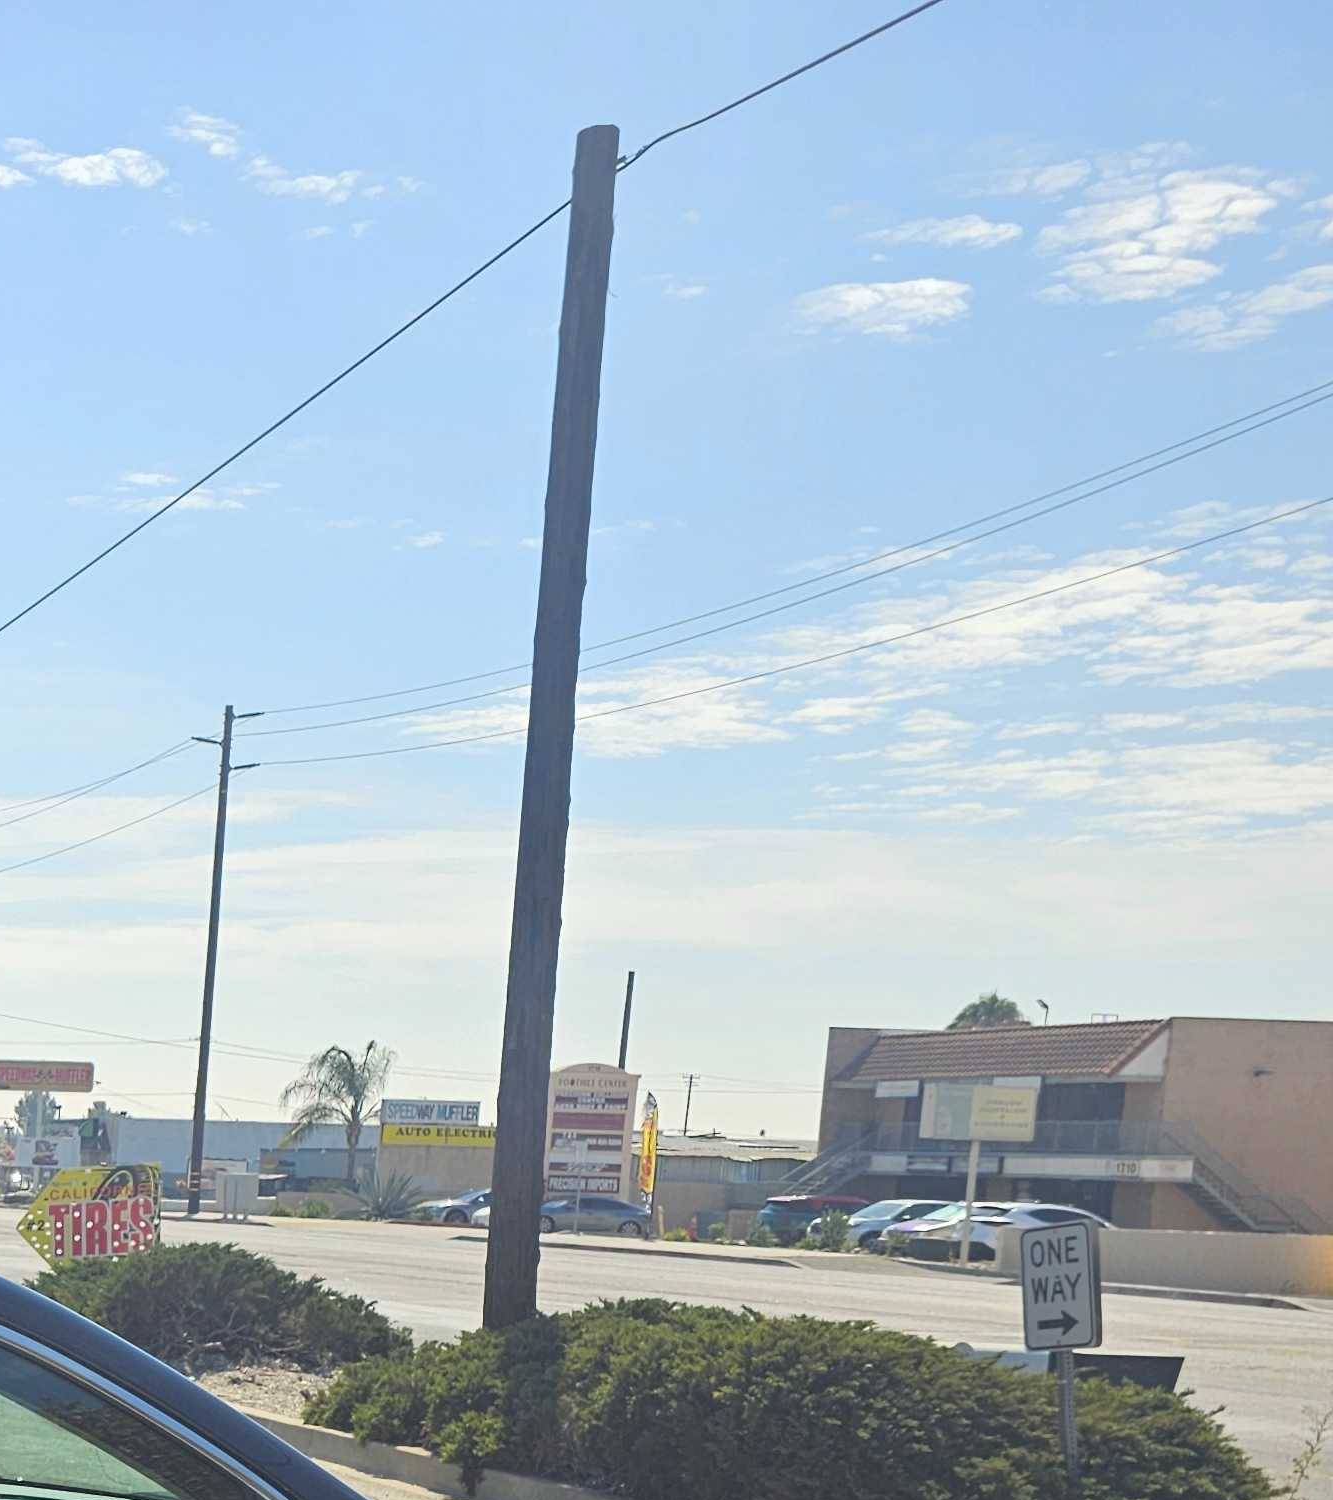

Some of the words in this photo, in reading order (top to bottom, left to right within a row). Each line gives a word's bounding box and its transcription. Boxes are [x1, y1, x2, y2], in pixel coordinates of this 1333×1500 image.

[388, 1102, 434, 1120] SPEEDWAY
[436, 1103, 479, 1121] MUFFLER
[395, 1126, 431, 1137] AUTO
[49, 1199, 155, 1256] TIRES
[1030, 1236, 1080, 1268] ONE
[1031, 1272, 1082, 1305] WAY
